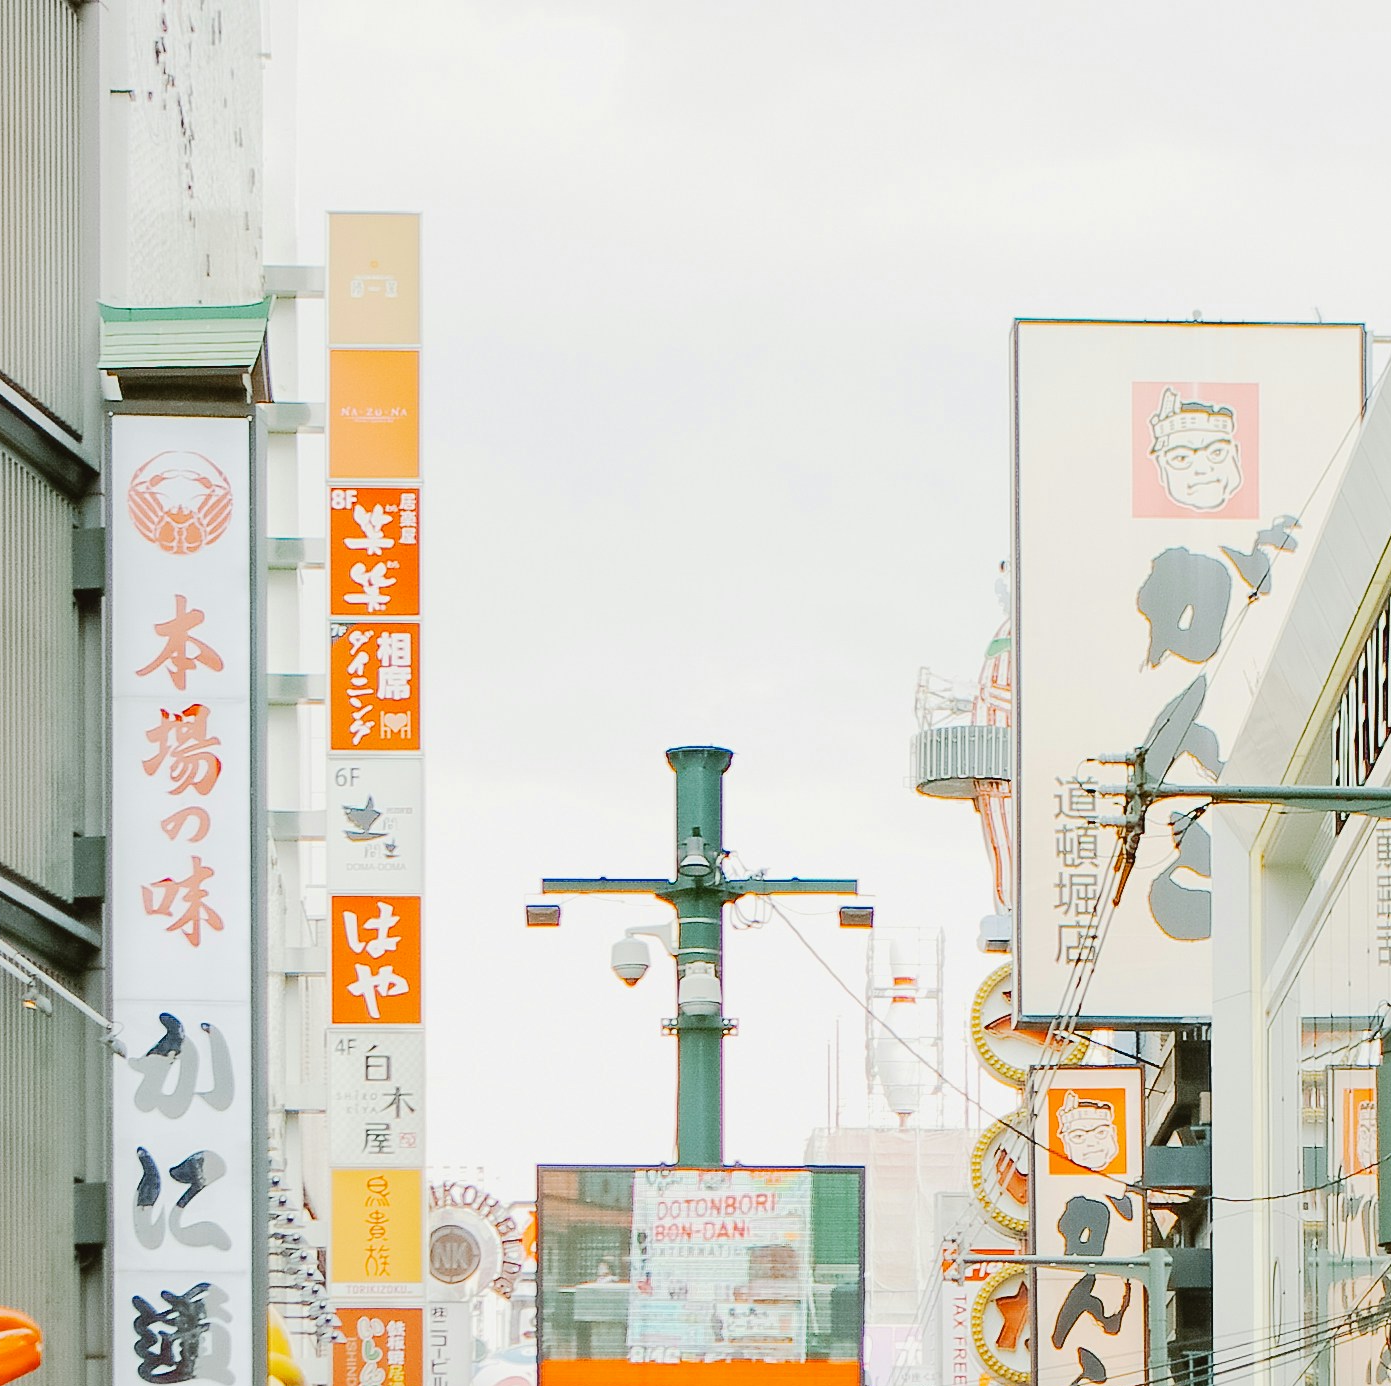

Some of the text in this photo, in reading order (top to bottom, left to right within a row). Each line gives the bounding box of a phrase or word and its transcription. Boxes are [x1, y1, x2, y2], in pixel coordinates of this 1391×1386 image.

[330, 489, 358, 510] 8F
[346, 630, 375, 746] ダイニング
[375, 631, 412, 701] 相席
[135, 594, 225, 948] 本場の味
[334, 767, 361, 788] 6F
[1053, 775, 1100, 966] 道頓堀店
[342, 901, 410, 1020] はや
[334, 1038, 357, 1056] 4F
[361, 1044, 417, 1155] 白木屋
[429, 1181, 499, 1219] IKOH
[655, 1192, 777, 1221] DOTONBORI
[365, 1175, 391, 1277] 鳥貴族
[653, 1219, 751, 1242] BON-DAN
[952, 1294, 967, 1328] TAX
[952, 1337, 968, 1386] FREE
